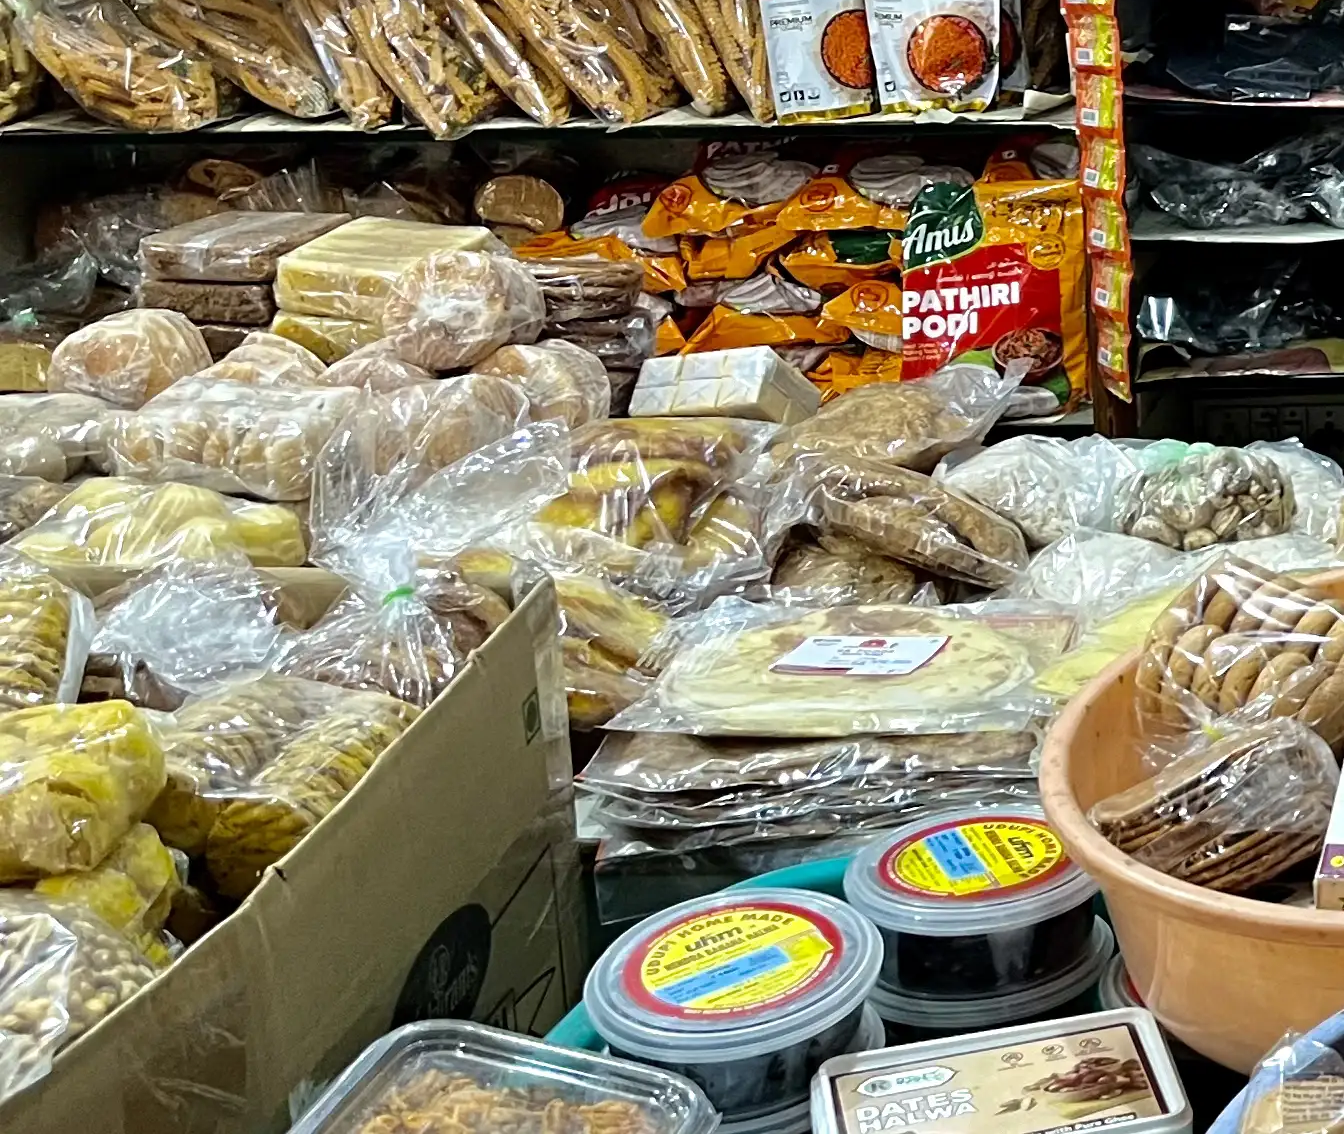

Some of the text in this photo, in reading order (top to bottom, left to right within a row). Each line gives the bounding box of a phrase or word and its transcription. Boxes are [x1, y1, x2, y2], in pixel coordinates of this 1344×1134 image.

[770, 15, 812, 28] PREMIUM
[902, 217, 975, 261] Amis
[902, 282, 1020, 314] PATHIRI
[902, 311, 978, 341] PODI
[646, 912, 797, 976] UDUPI HOME MADE
[683, 925, 744, 953] uhm
[855, 1087, 975, 1124] DATES
[858, 1103, 979, 1134] HALWA
[1074, 1119, 1102, 1132] Pure
[1104, 1112, 1136, 1126] Ghee
